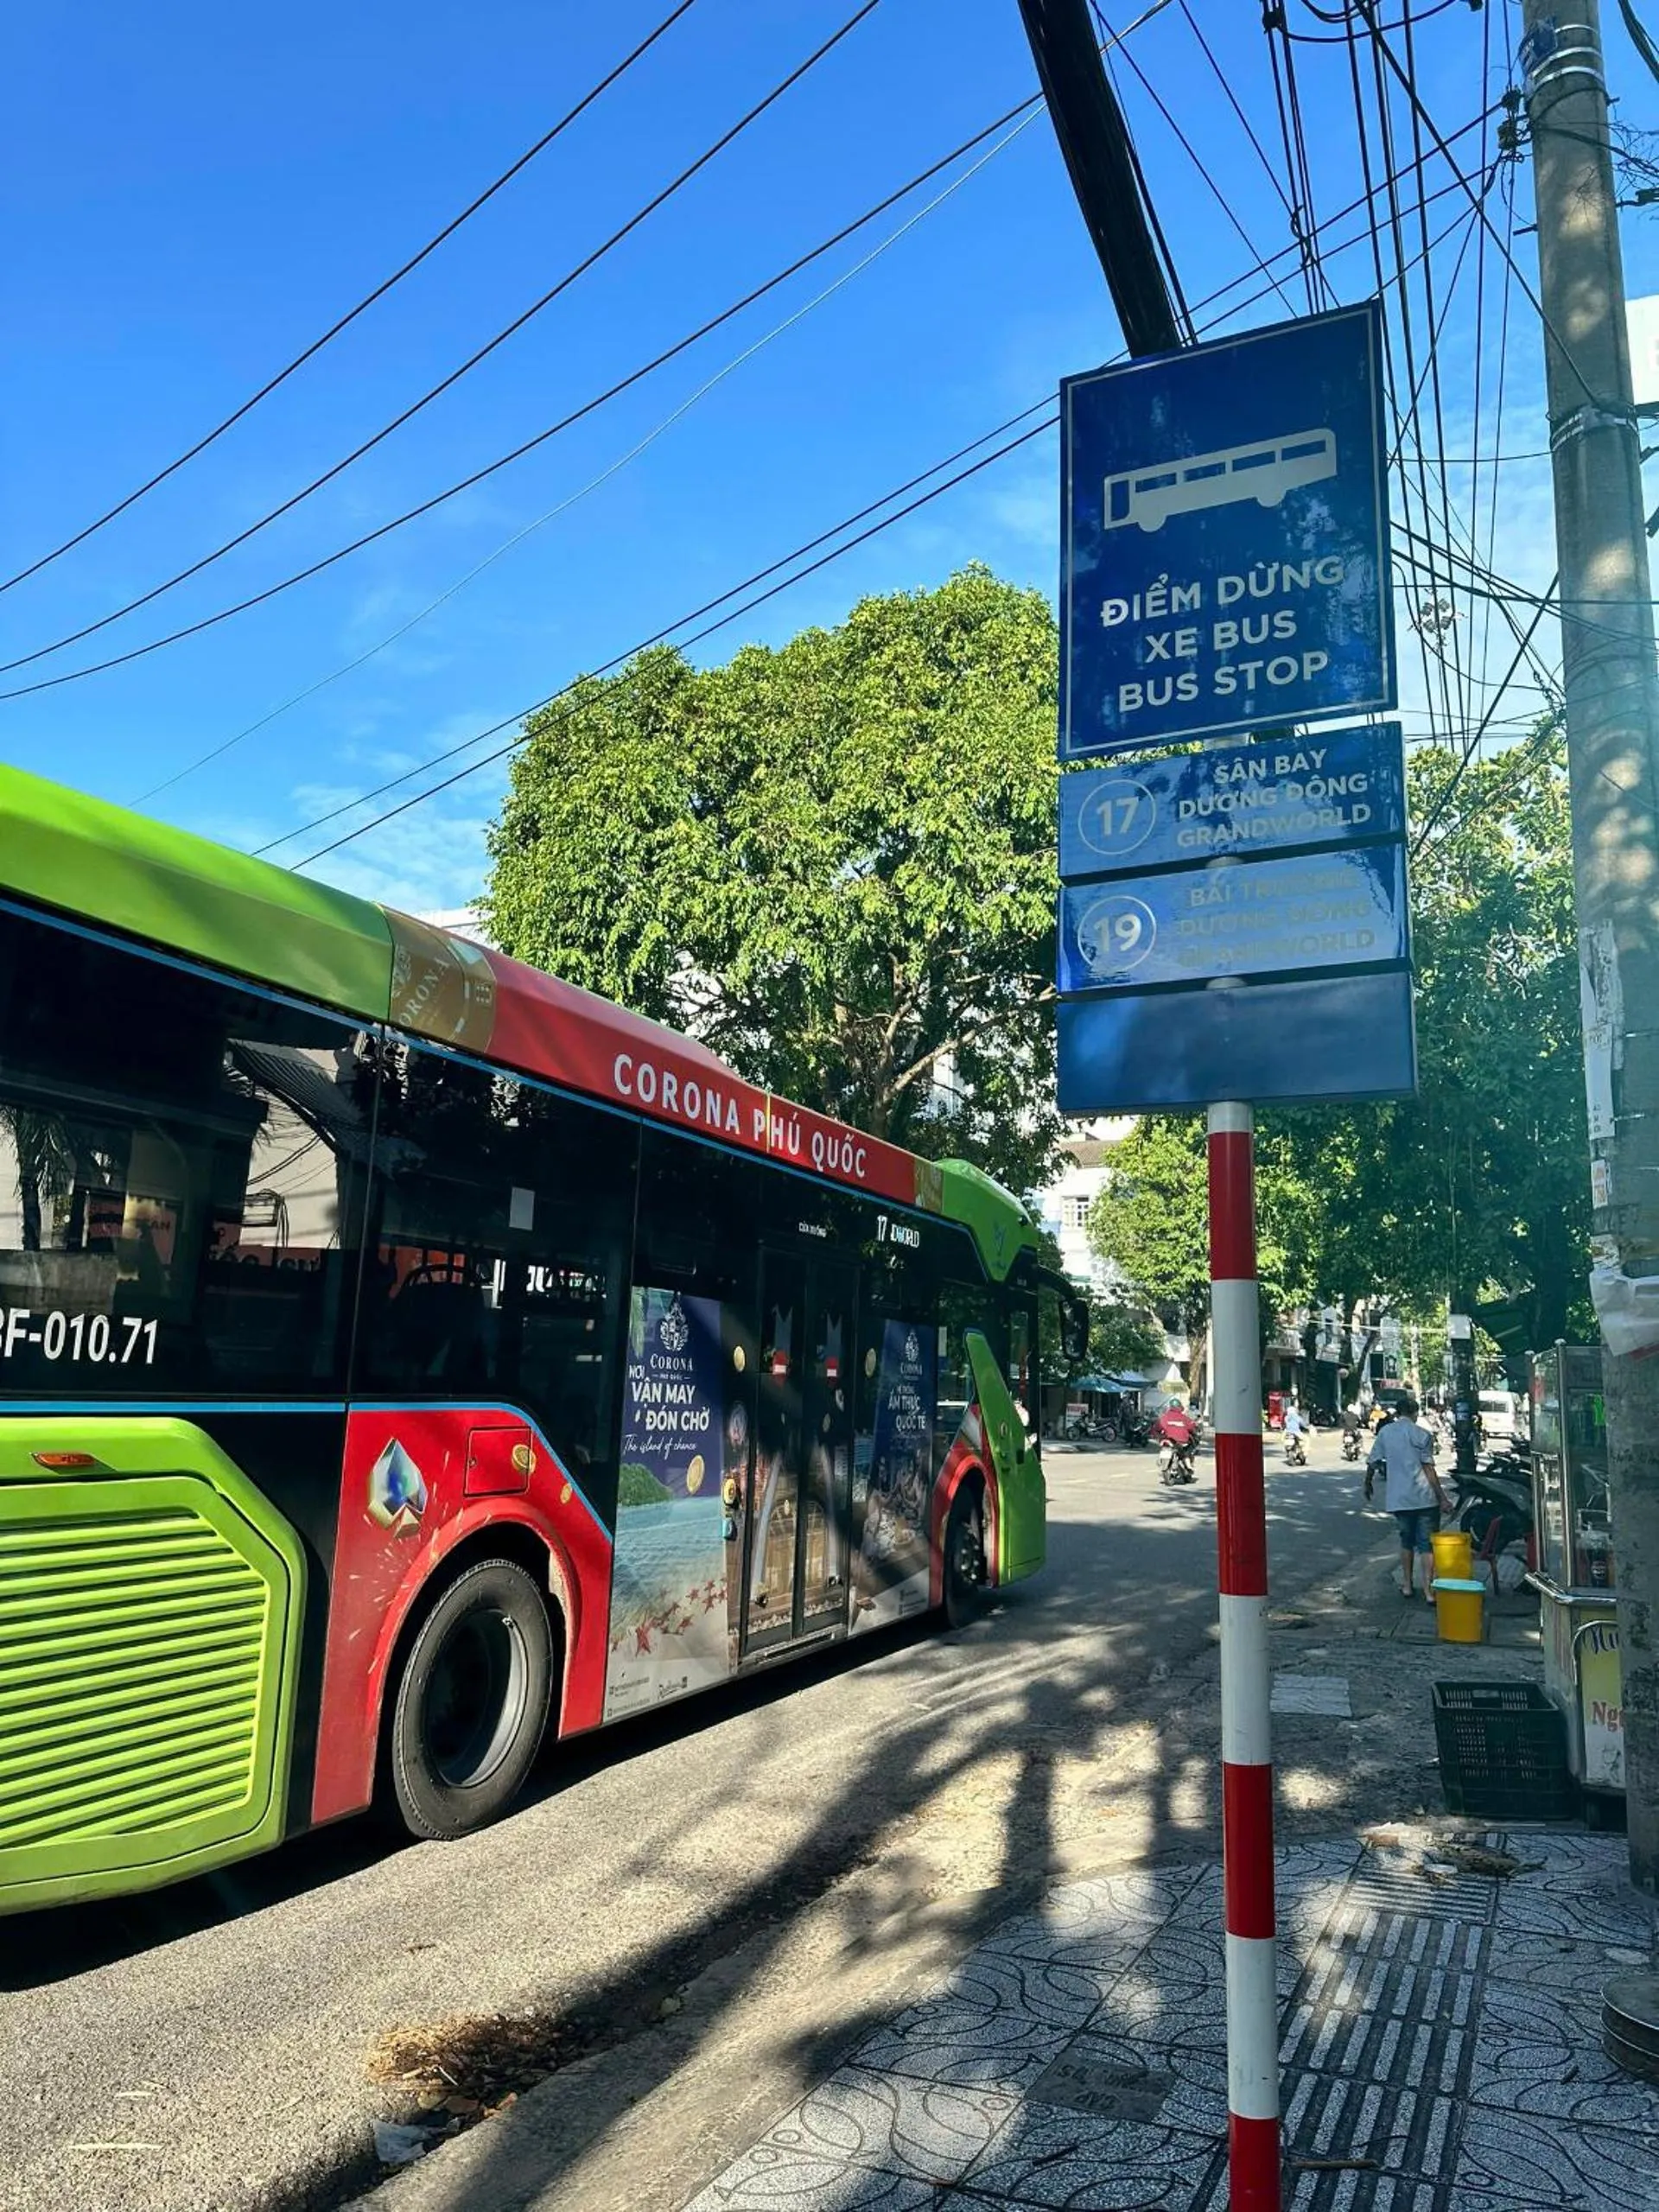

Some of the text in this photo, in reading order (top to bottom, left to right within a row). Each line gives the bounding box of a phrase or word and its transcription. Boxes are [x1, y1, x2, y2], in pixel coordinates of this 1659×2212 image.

[1100, 555, 1344, 627] ĐIỂM DỪNG
[1145, 610, 1297, 664] XE BUS
[1119, 651, 1328, 713] BUS STOP
[1214, 749, 1327, 784] SÂN BAY
[1096, 796, 1139, 836] 17
[1177, 804, 1371, 848] GRANDWORLD
[1094, 913, 1141, 951] 19
[398, 957, 449, 1027] ORONA
[614, 1053, 866, 1178] CORONA PHÚ QUỐC
[877, 1215, 888, 1242] 17
[0, 1307, 157, 1364] F-010.71
[650, 1353, 693, 1371] CORONA
[632, 1376, 696, 1408] VẬN MAY
[645, 1405, 677, 1431] ĐÓN
